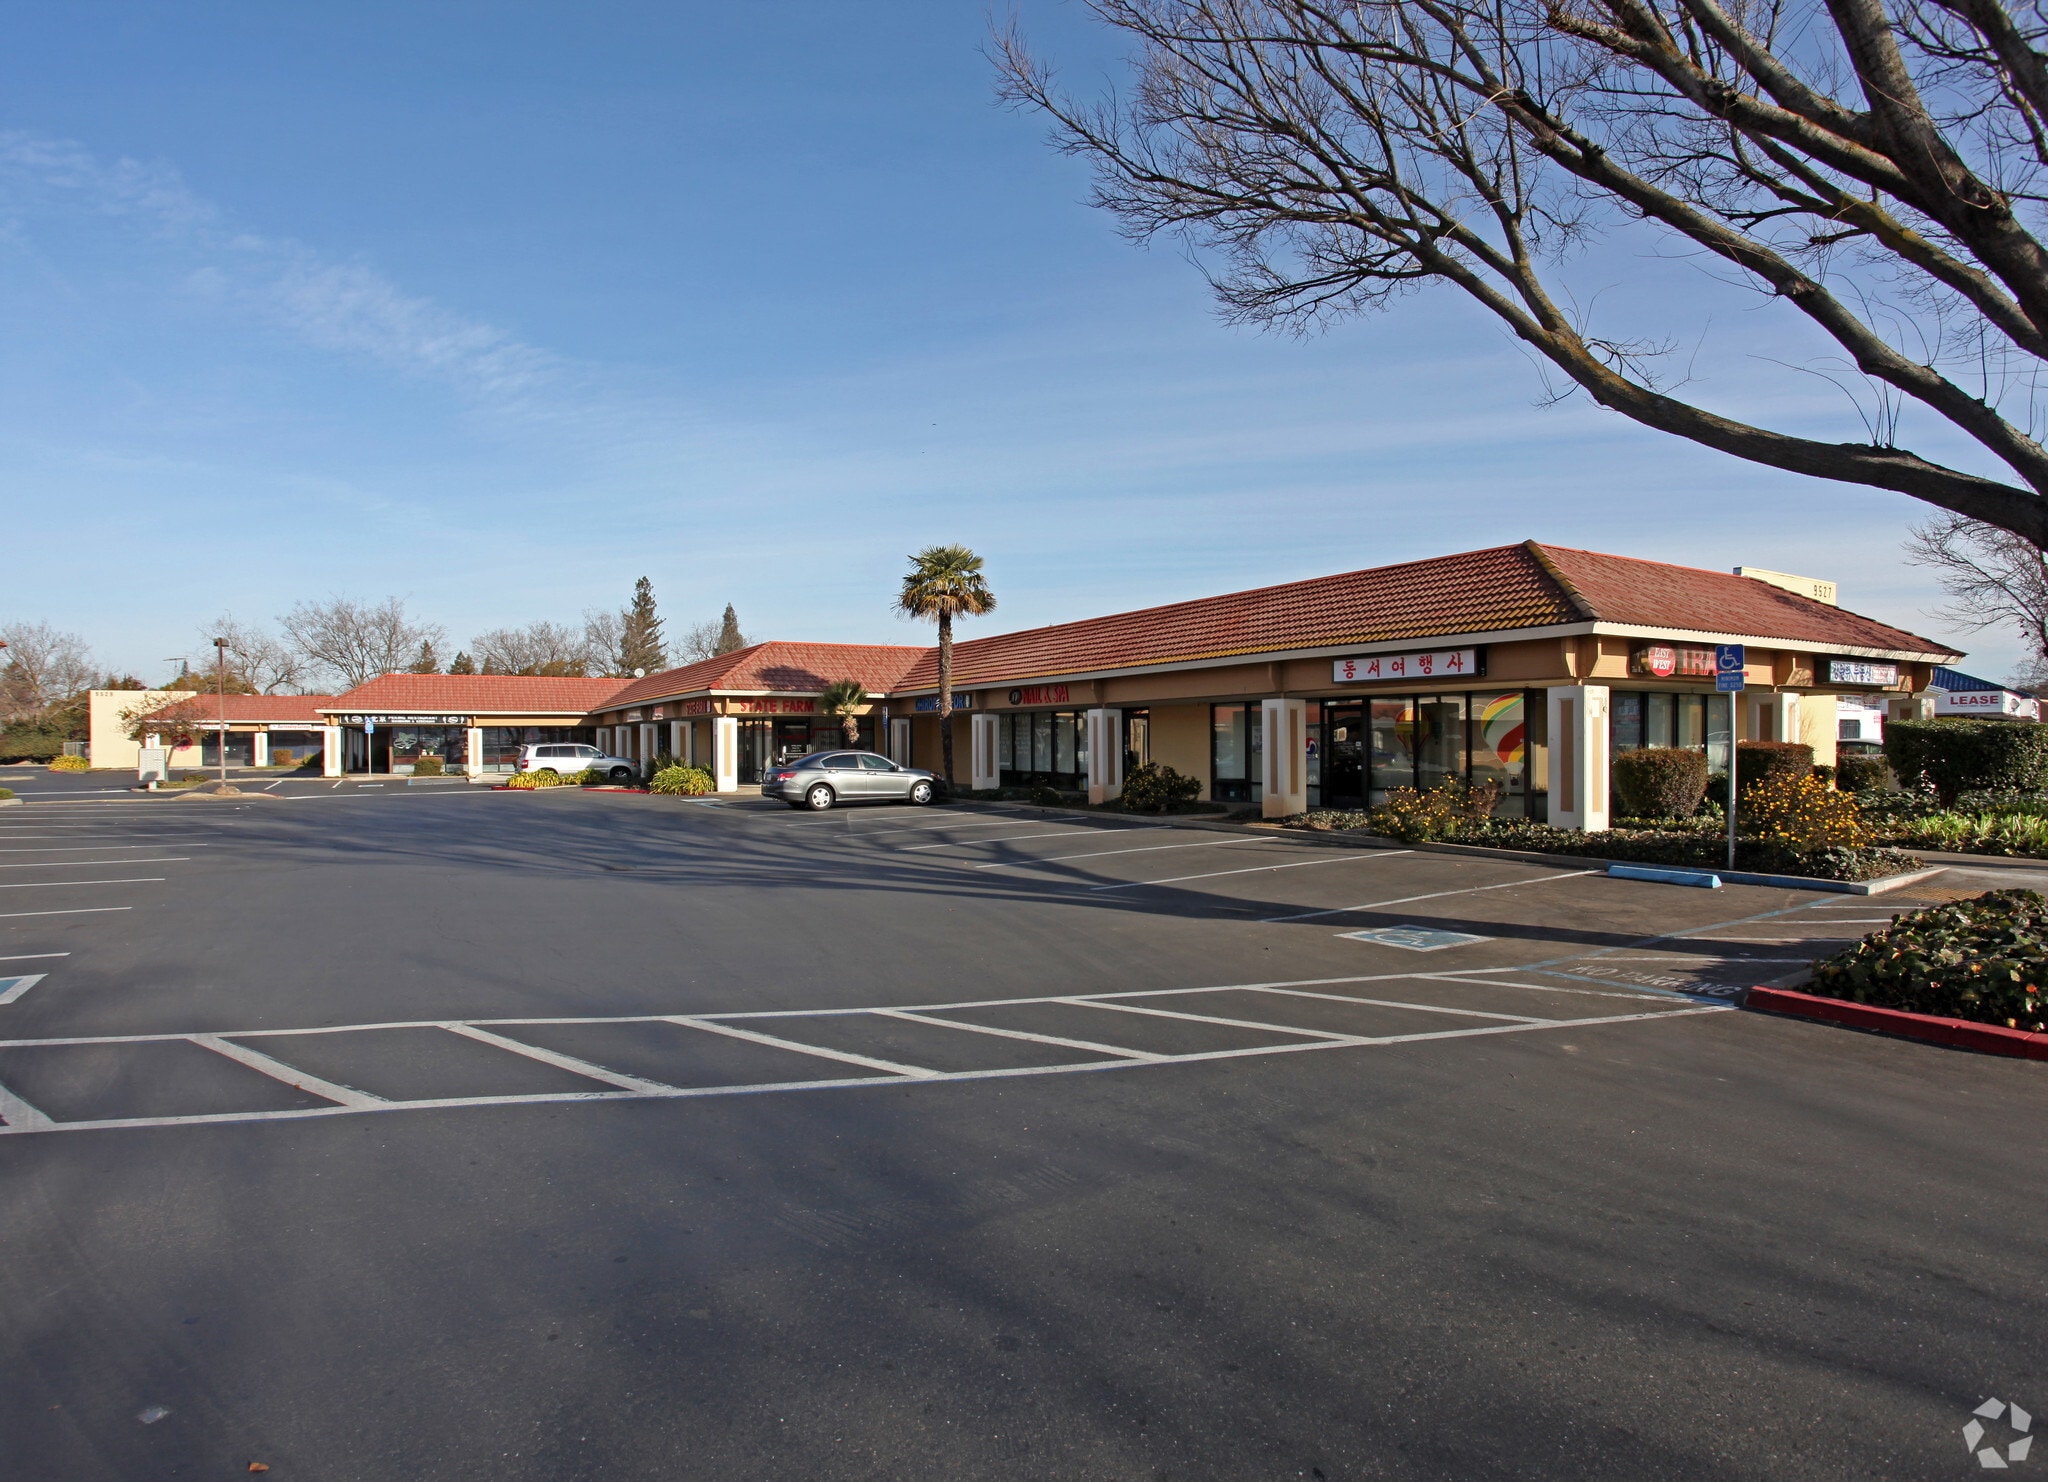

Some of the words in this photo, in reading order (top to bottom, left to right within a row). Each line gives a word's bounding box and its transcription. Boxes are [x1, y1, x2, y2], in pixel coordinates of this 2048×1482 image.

[1813, 584, 1832, 599] 9527
[1654, 647, 1670, 658] EAST
[1343, 651, 1463, 680] 동서여행사
[1652, 659, 1671, 670] WEST
[1023, 688, 1042, 704] NAIL
[1043, 687, 1052, 703] &
[1053, 685, 1070, 702] SPA
[1950, 695, 1999, 705] LEASE
[740, 700, 777, 712] STATE
[782, 700, 815, 712] FARM
[1569, 965, 1618, 976] NO
[1619, 971, 1741, 996] PARKING
